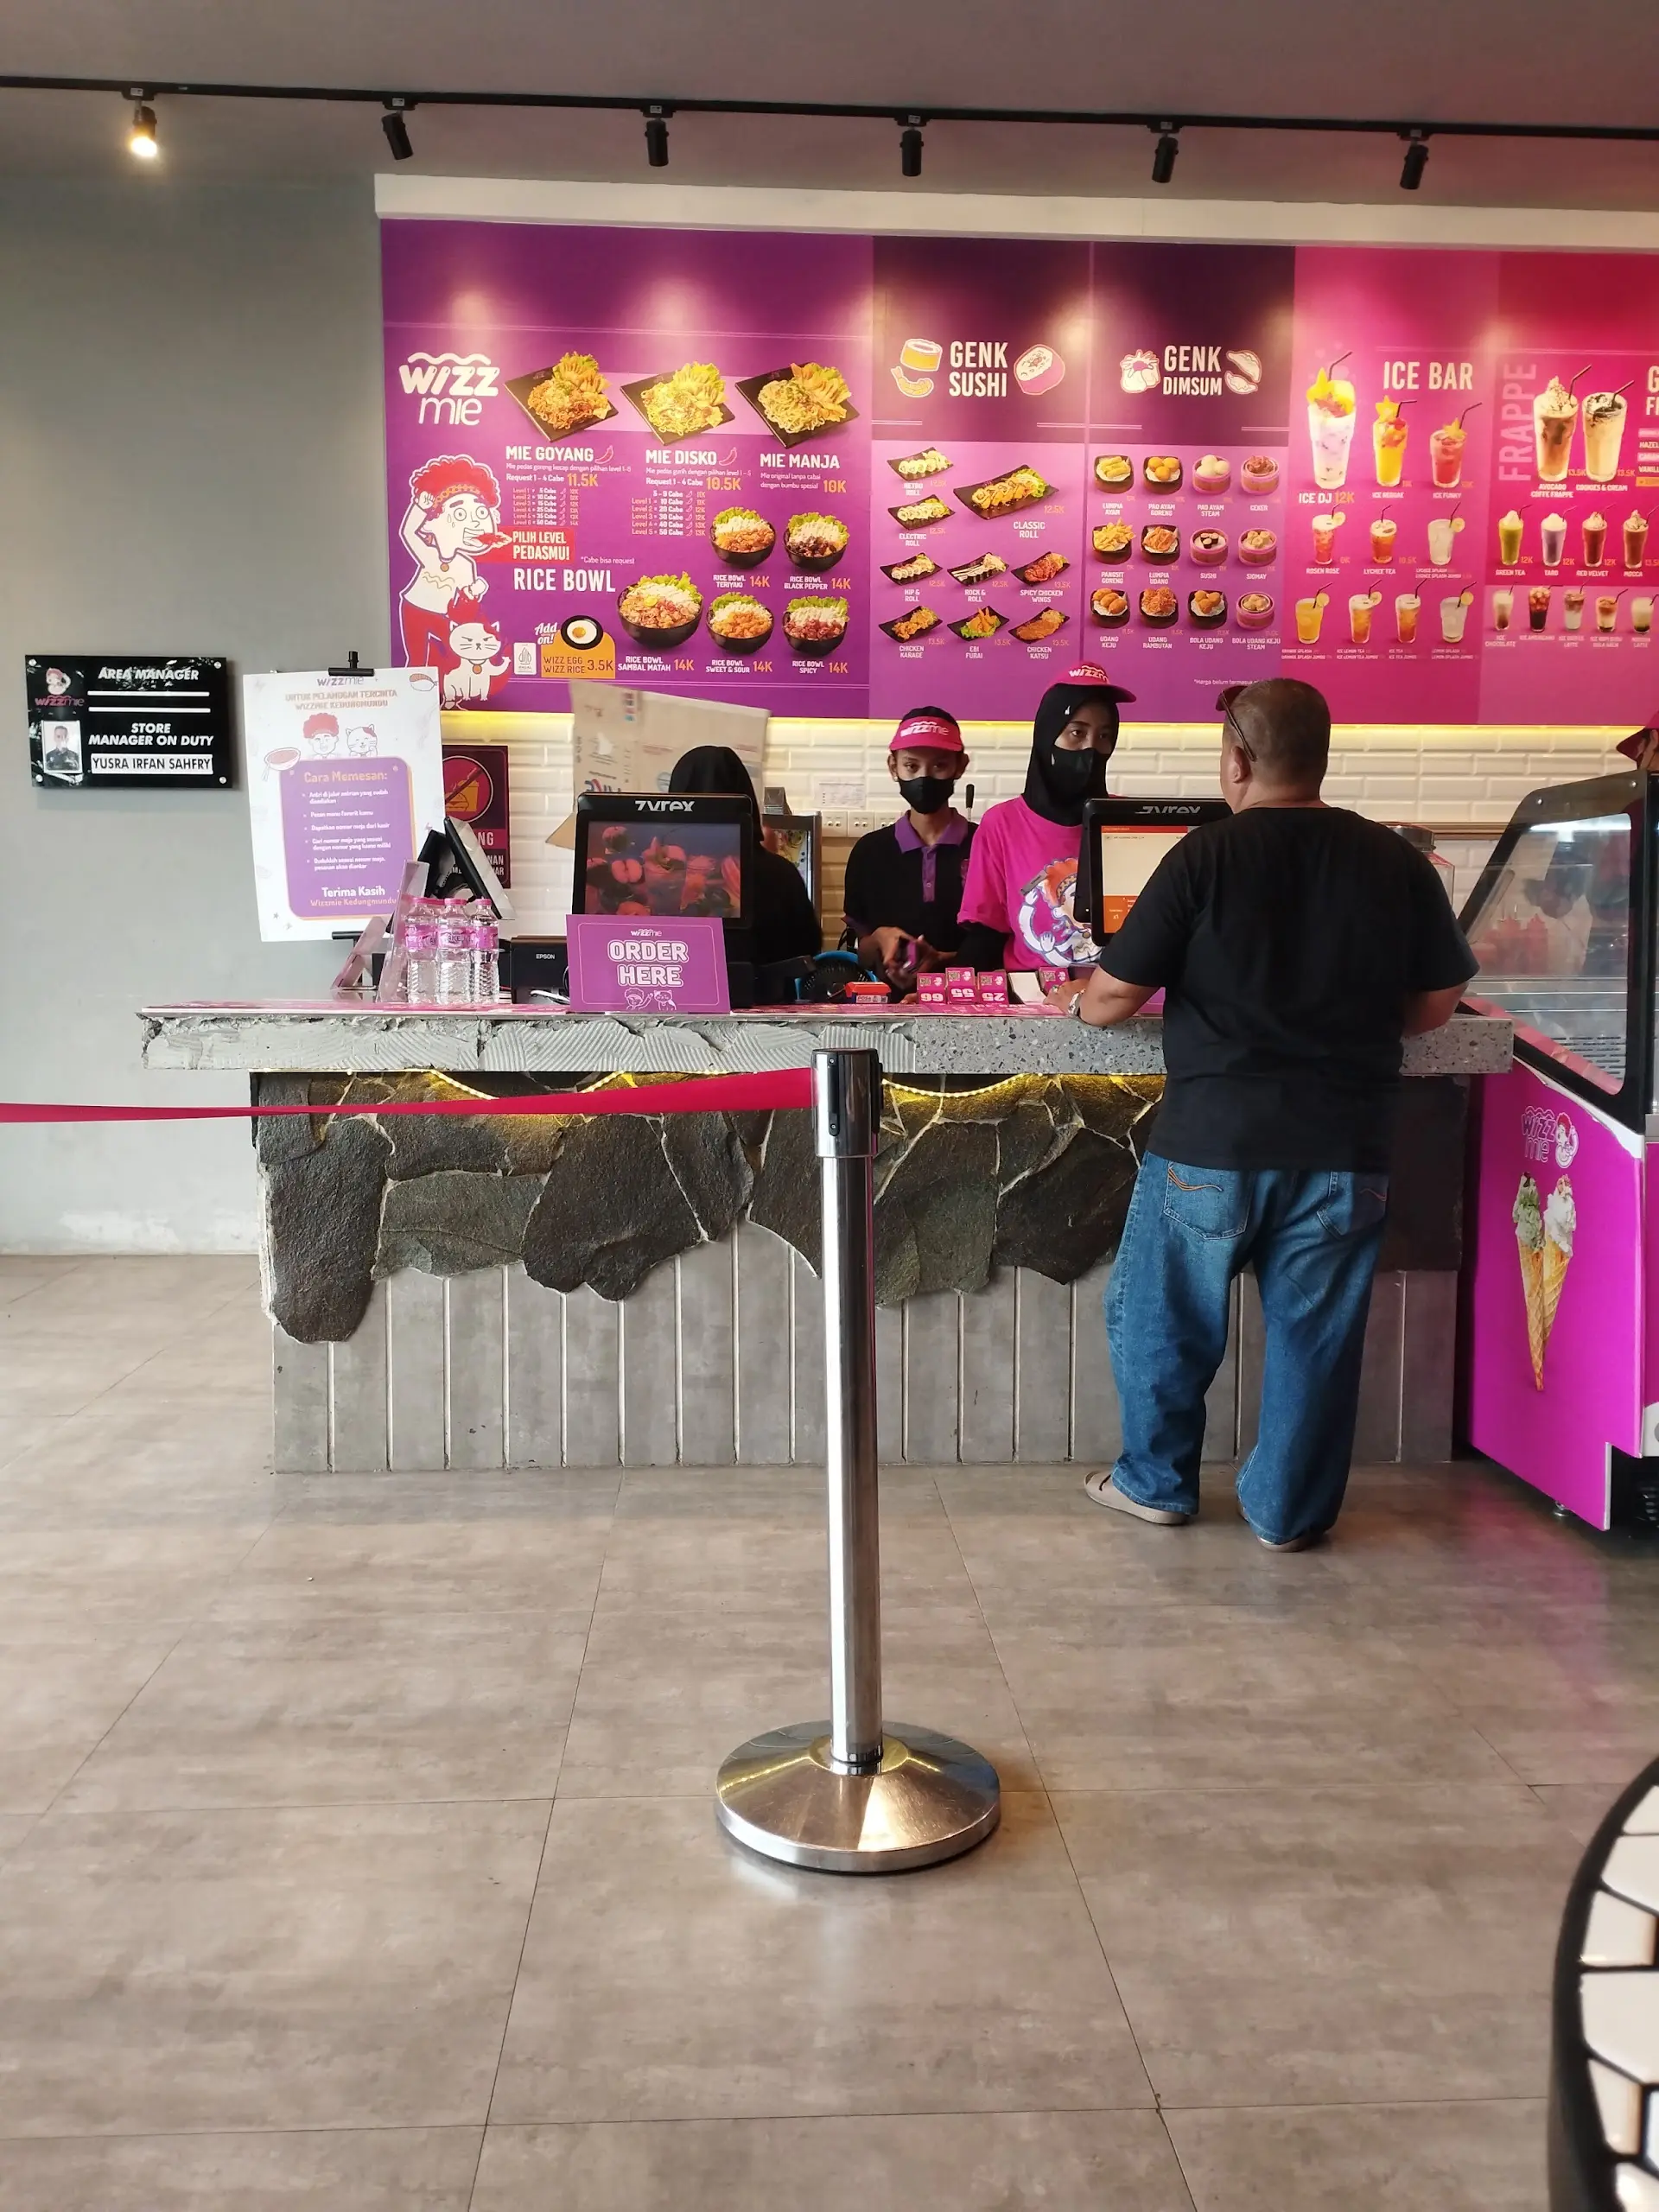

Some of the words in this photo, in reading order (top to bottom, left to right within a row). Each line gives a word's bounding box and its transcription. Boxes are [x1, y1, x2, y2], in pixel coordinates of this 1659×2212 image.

[950, 341, 1008, 368] GENK
[1164, 346, 1221, 372] GENK
[398, 365, 499, 396] WIZZ
[1383, 361, 1420, 390] ICE
[1429, 362, 1473, 390] BAR
[949, 372, 1007, 397] SUSHI
[1163, 377, 1222, 396] DIMSUM
[1498, 364, 1536, 480] FRAPPE
[505, 446, 531, 460] MIE
[536, 447, 594, 461] GOYANG
[645, 449, 671, 465] MIE
[676, 450, 717, 466] DISKO
[760, 454, 785, 467] MIE
[789, 454, 840, 469] MANJA
[506, 474, 532, 482] Request
[567, 474, 598, 486] 11.5K
[646, 478, 672, 486] Request
[706, 477, 741, 491] 10.5K
[823, 480, 846, 493] 10K
[1299, 493, 1317, 504] ICE
[1318, 493, 1332, 504] DJ
[1334, 493, 1355, 504] 12K
[512, 531, 536, 543] PILIH
[539, 532, 566, 543] LEVEL
[513, 545, 569, 560] PEDASMU!
[514, 569, 556, 590] RICE
[563, 569, 615, 592] BOWL
[750, 575, 770, 588] 14K
[831, 578, 851, 589] 14K
[535, 622, 557, 635] Add
[537, 632, 554, 645] on!
[588, 659, 613, 671] 3.5K
[674, 659, 694, 671] 14K
[753, 661, 772, 672] 14K
[829, 662, 849, 673] 14K
[98, 667, 130, 680] AREA
[135, 667, 199, 680] MANAGER
[285, 693, 311, 702] UNTUK
[313, 691, 359, 700] PELANGGAN
[360, 690, 397, 698] TERCINTA
[131, 723, 171, 734] STORE
[88, 735, 153, 745] MANAGER
[156, 736, 177, 746] ON
[181, 736, 213, 746] DUTY
[92, 758, 129, 769] YUSRA
[132, 758, 164, 769] IRFAN
[168, 758, 212, 770] SAHFRY
[304, 772, 329, 783] Cara
[332, 771, 388, 781] Memesan:
[321, 887, 356, 897] Terima
[358, 886, 385, 896] Kasih
[344, 899, 397, 907] Kedungmundu
[607, 939, 689, 963] ORDER
[617, 964, 683, 987] HERE
[1521, 1113, 1556, 1142] WIZZ
